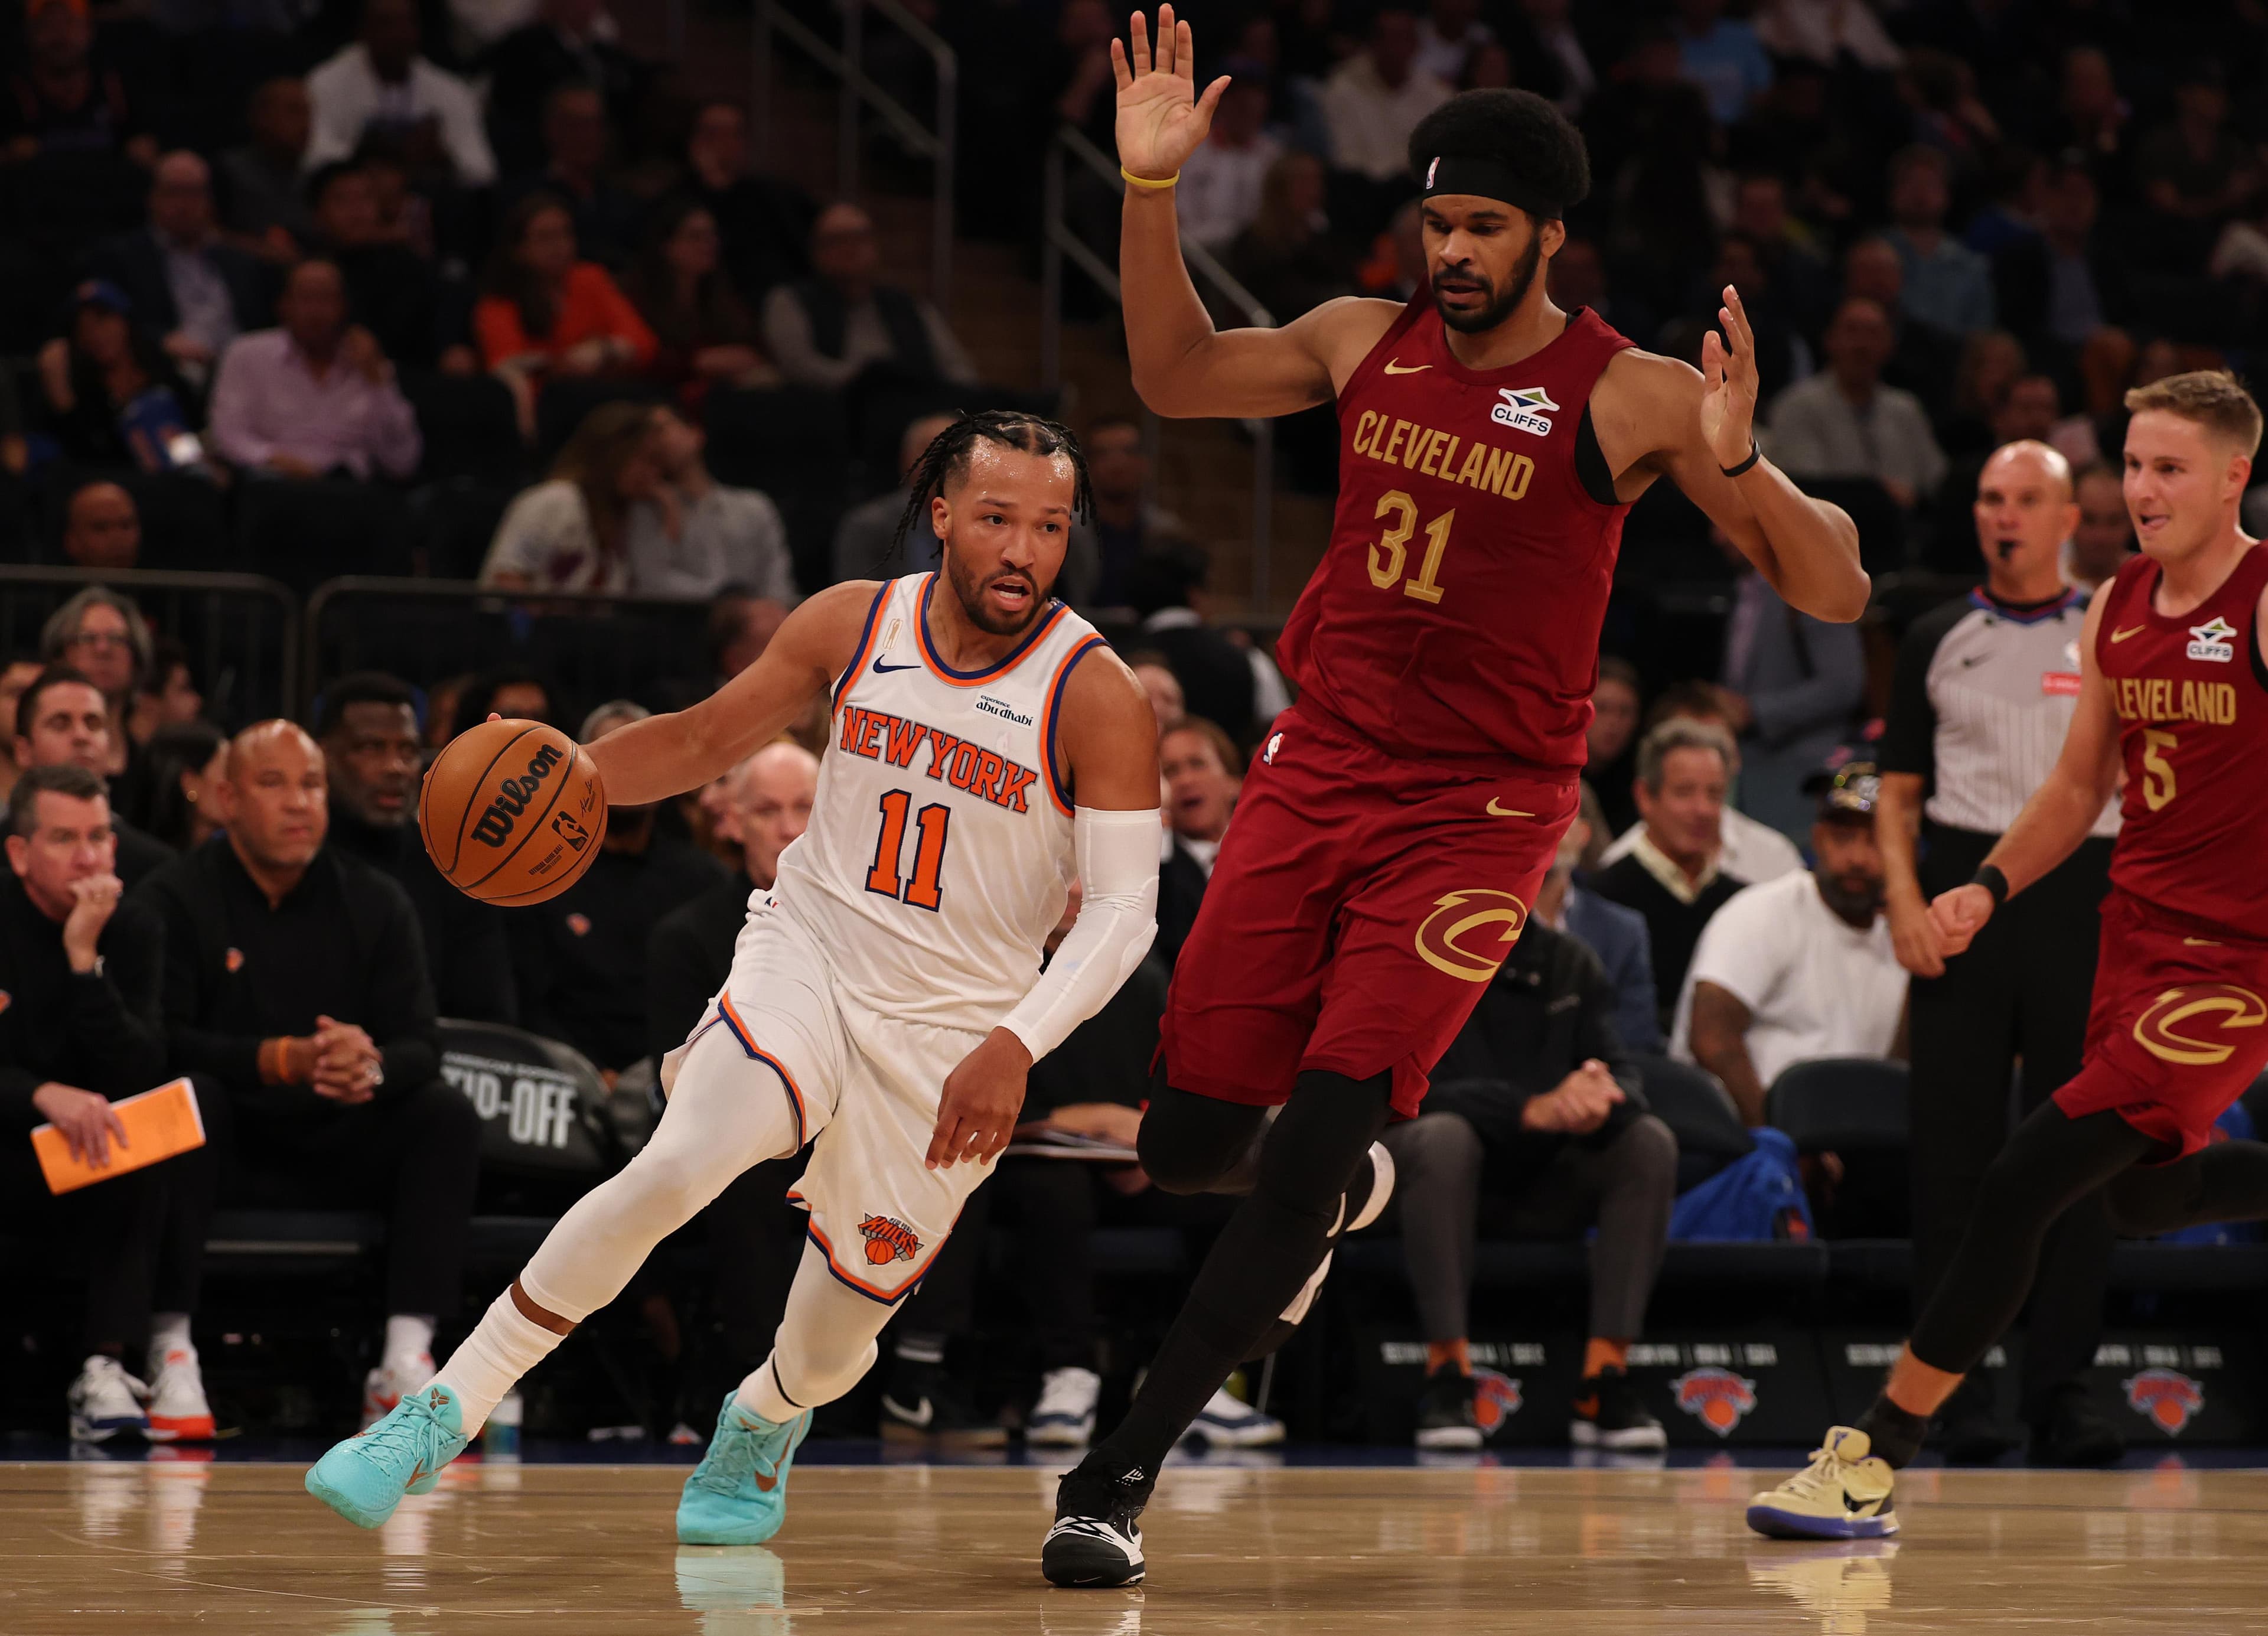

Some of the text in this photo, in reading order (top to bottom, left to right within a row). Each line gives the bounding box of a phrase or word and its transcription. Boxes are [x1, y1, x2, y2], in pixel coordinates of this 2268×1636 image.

[1494, 408, 1549, 432] CLIFFS
[1353, 410, 1534, 501] CLEVELAND
[1367, 489, 1455, 604] 31
[2189, 646, 2230, 658] CLIFFS
[976, 702, 1034, 726] abu dhabi
[980, 695, 1011, 708] experience
[2108, 677, 2237, 725] LEVELAND
[840, 707, 1040, 815] NEW YORK
[2142, 728, 2178, 812] 5
[470, 744, 564, 848] Wilson
[865, 788, 951, 912] 11
[858, 1216, 918, 1259] KNICKS
